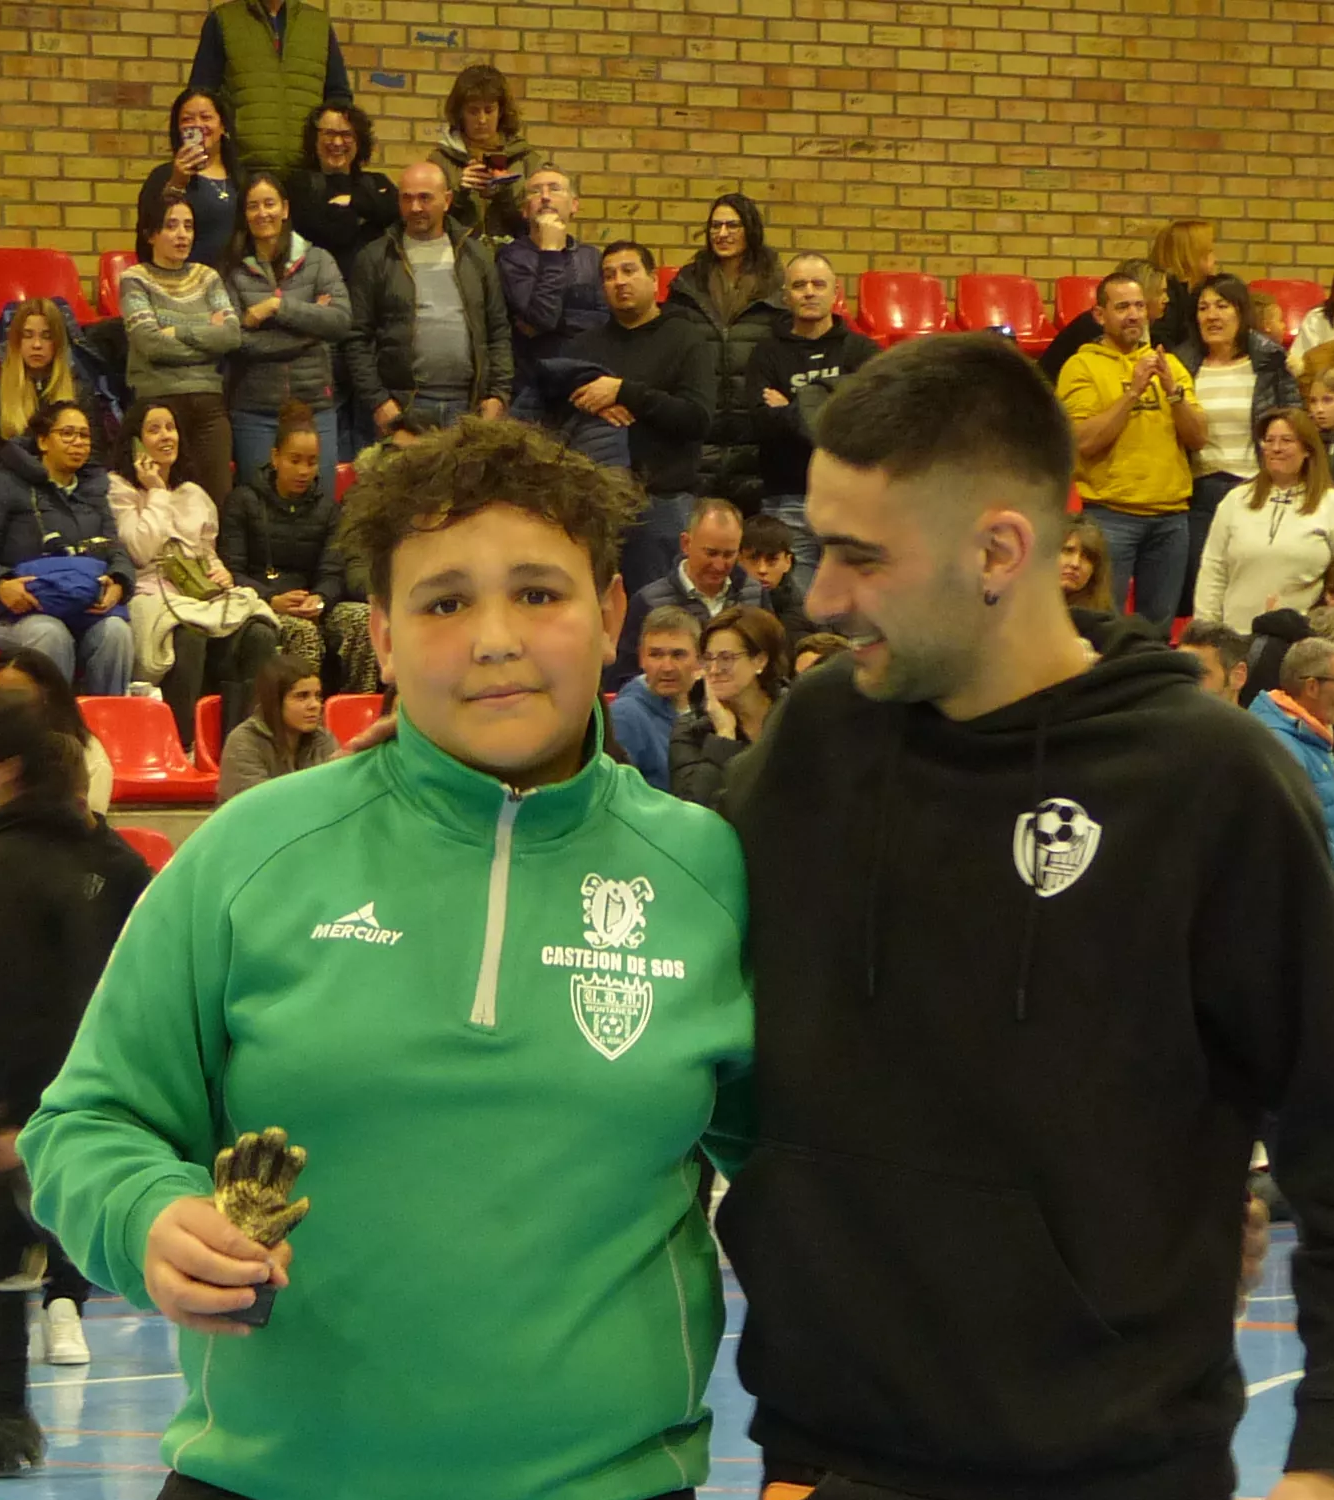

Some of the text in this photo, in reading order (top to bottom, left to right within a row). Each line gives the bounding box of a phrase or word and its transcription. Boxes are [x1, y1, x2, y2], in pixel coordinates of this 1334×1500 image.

[310, 923, 404, 946] MERCURY
[541, 946, 685, 979] CASTEJON DE SOS
